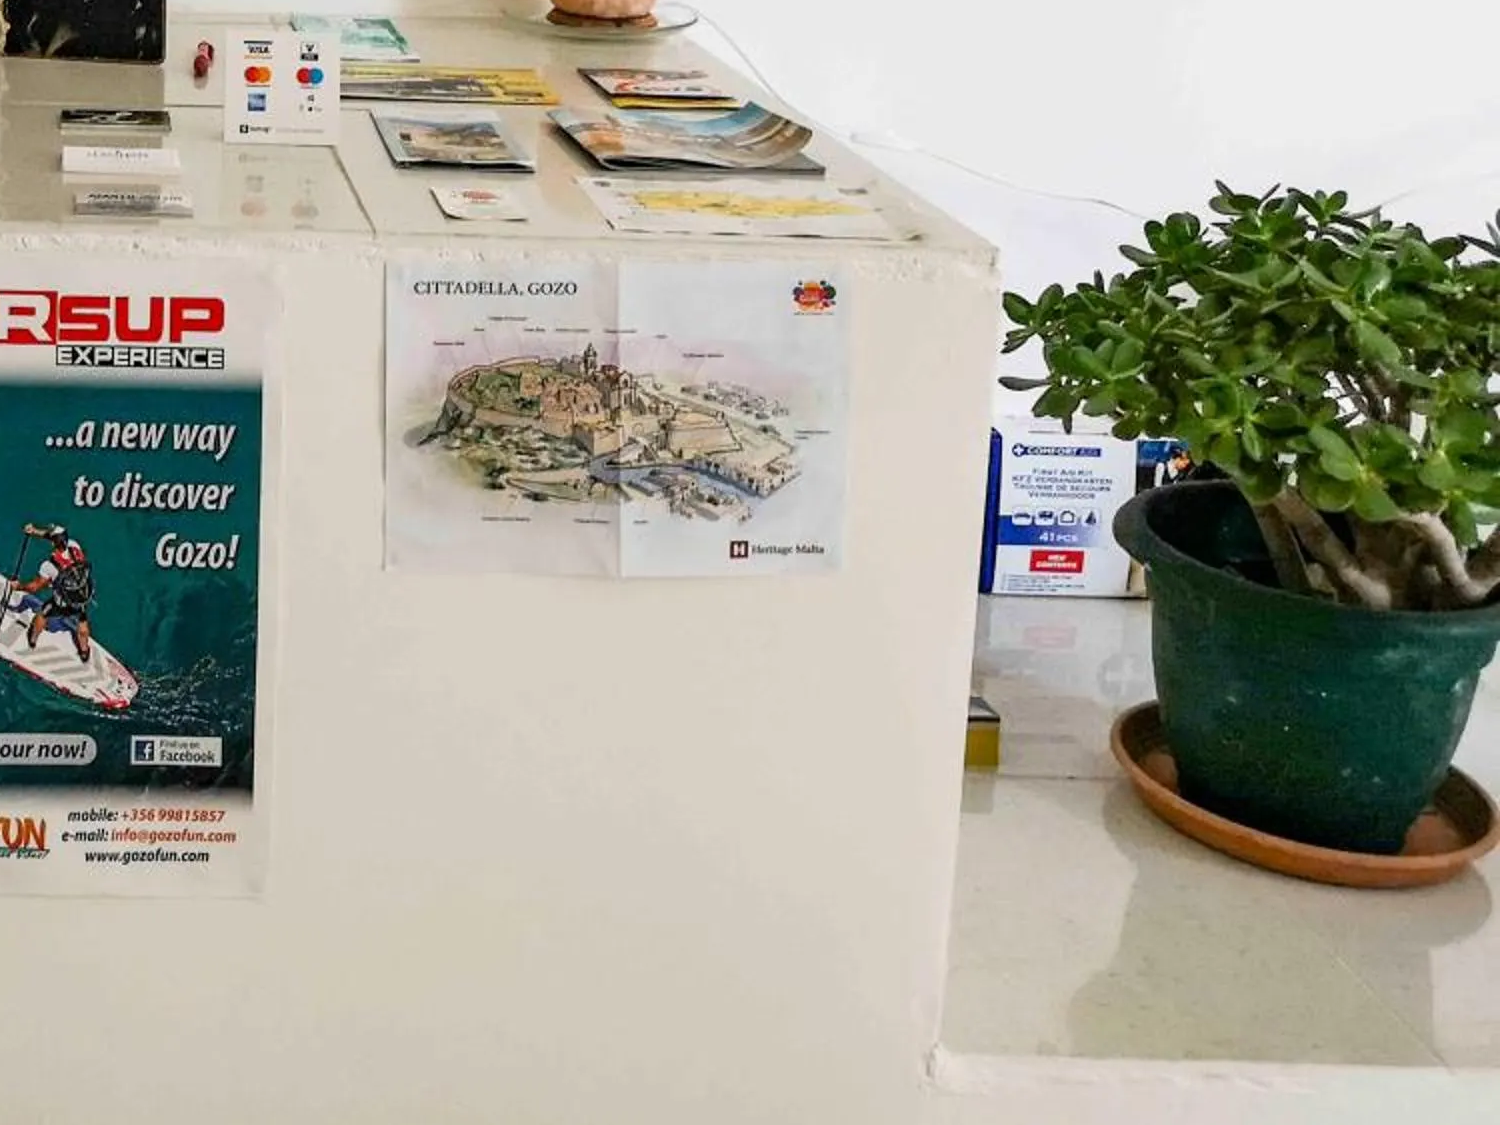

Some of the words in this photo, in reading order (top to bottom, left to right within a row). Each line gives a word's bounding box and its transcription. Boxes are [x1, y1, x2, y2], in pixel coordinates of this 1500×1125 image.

[413, 281, 524, 296] CITTADELLA,
[527, 281, 578, 295] GOZO
[57, 346, 224, 368] EXPERIENCE
[101, 422, 164, 450] new
[172, 424, 236, 460] way
[74, 475, 104, 507] to
[111, 473, 235, 511] discover
[155, 532, 239, 570] Gozo!
[795, 544, 825, 554] Malta
[38, 740, 87, 759] now!
[160, 750, 216, 763] Facebook
[67, 808, 119, 823] mobile:
[122, 808, 155, 823] +356
[61, 828, 109, 842] e-mail:
[111, 828, 237, 844] info@gozofun.com
[84, 848, 210, 865] www.gozofun.com
